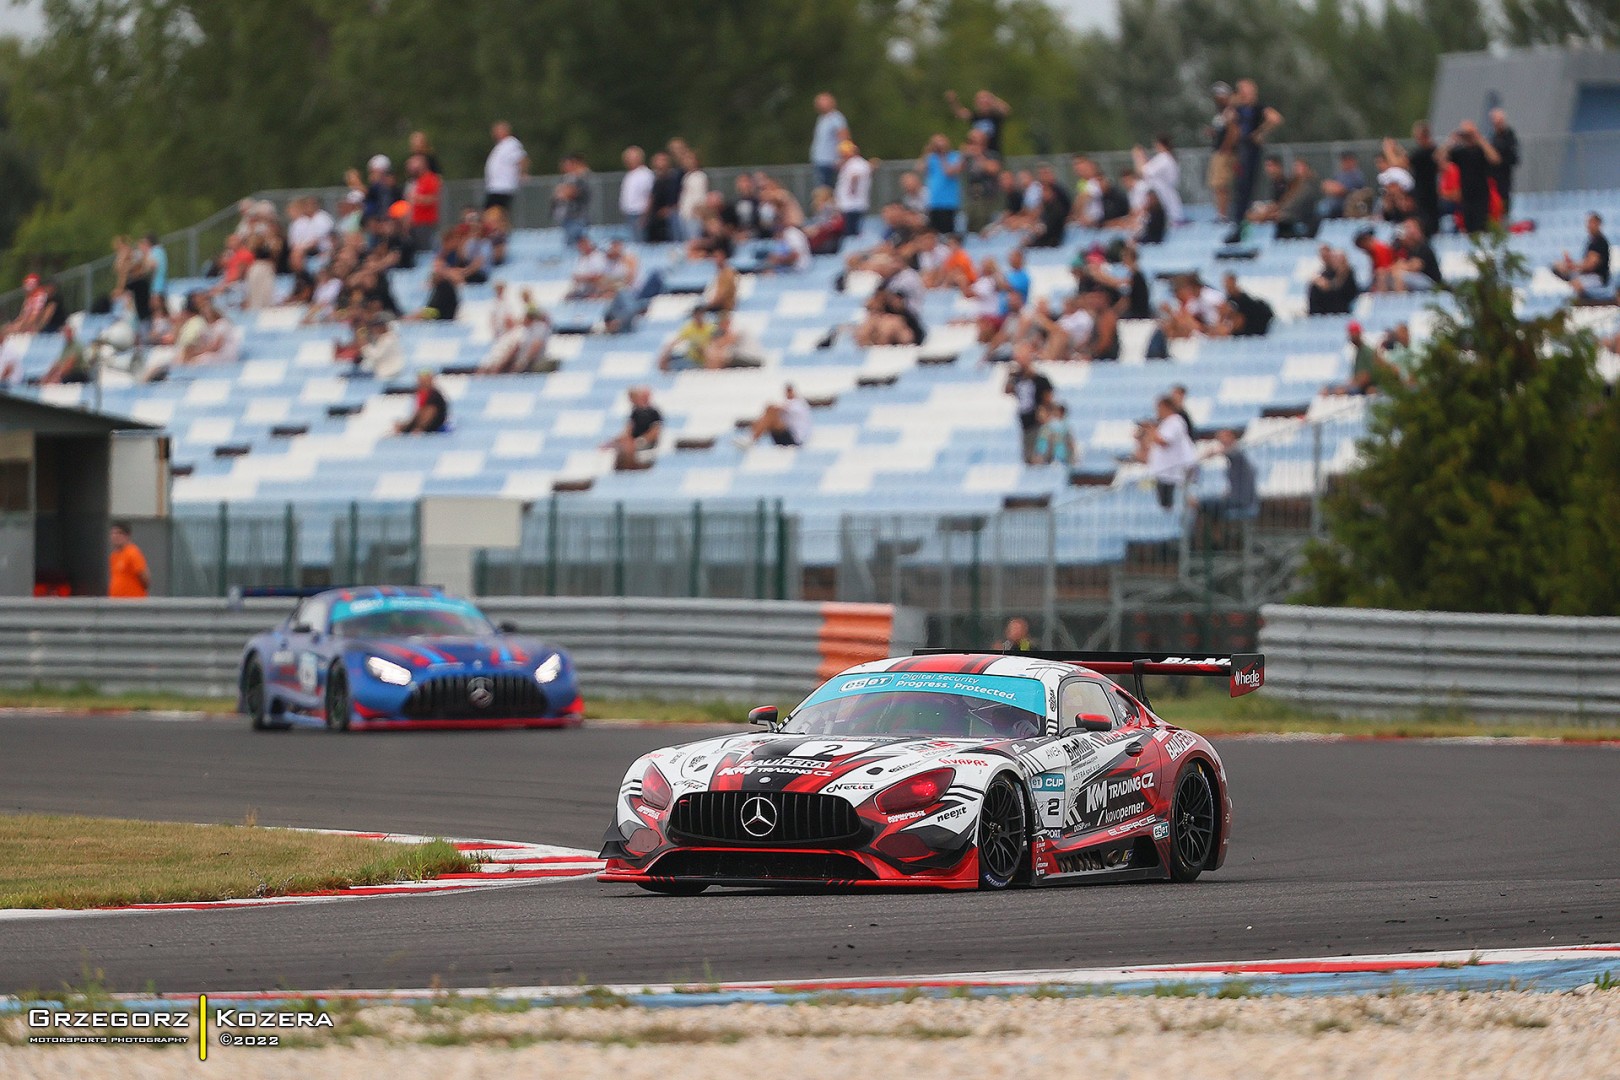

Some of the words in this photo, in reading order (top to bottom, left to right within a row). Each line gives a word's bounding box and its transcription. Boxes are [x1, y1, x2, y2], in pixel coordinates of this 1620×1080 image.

[900, 673, 935, 682] Digital
[937, 674, 980, 684] Security
[1240, 670, 1260, 685] hede
[896, 680, 950, 690] Progress.
[954, 683, 1017, 700] Protected.
[813, 745, 843, 760] 2
[717, 767, 756, 776] KM
[757, 767, 812, 775] TRADING
[1045, 778, 1064, 787] CUP
[1086, 780, 1107, 813] KM
[1108, 776, 1140, 799] TRADING
[1141, 772, 1155, 789] CZ
[937, 806, 967, 822] neext
[1048, 798, 1060, 816] 2
[1105, 801, 1145, 823] kovoperner
[1108, 814, 1157, 836] ELSPACE
